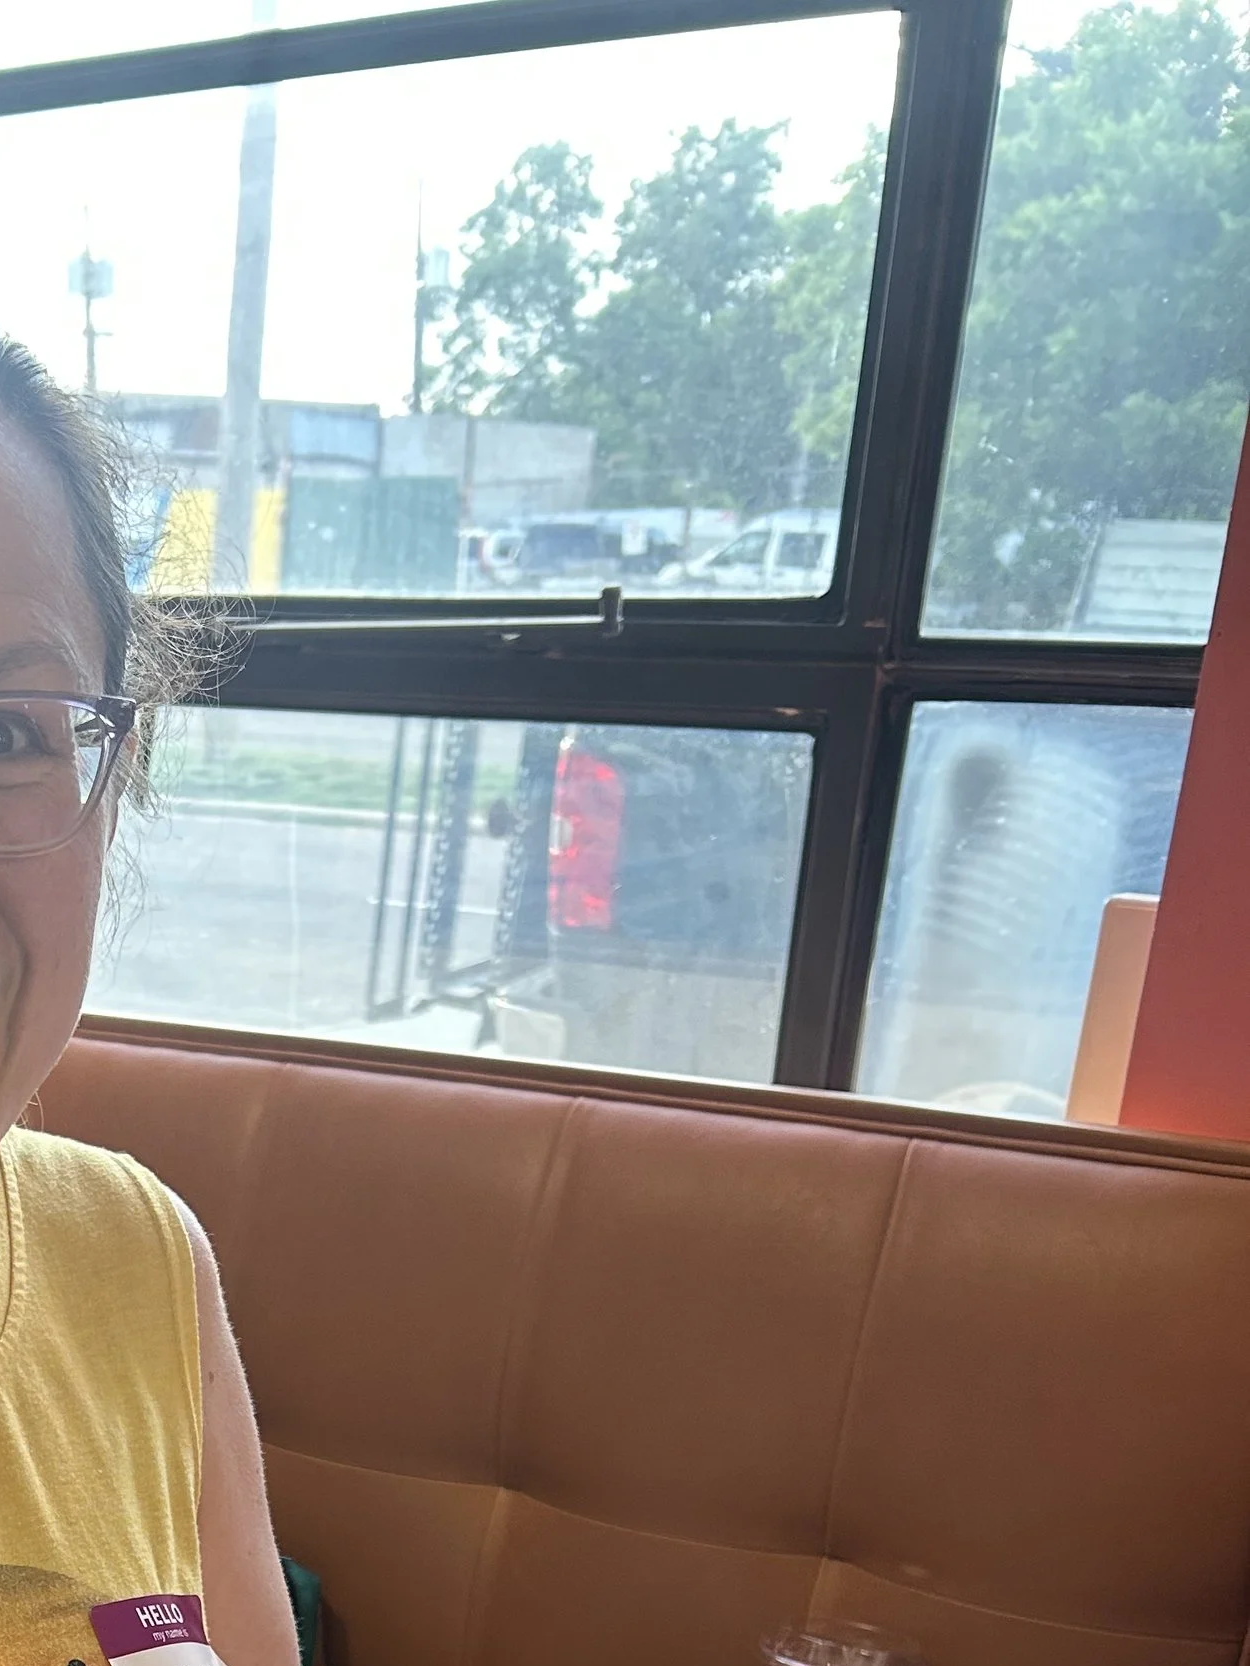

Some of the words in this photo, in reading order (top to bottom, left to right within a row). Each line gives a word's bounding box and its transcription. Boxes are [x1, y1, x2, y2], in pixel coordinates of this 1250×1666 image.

[136, 1602, 184, 1628] HELLO
[153, 1629, 166, 1643] my
[165, 1627, 184, 1641] name
